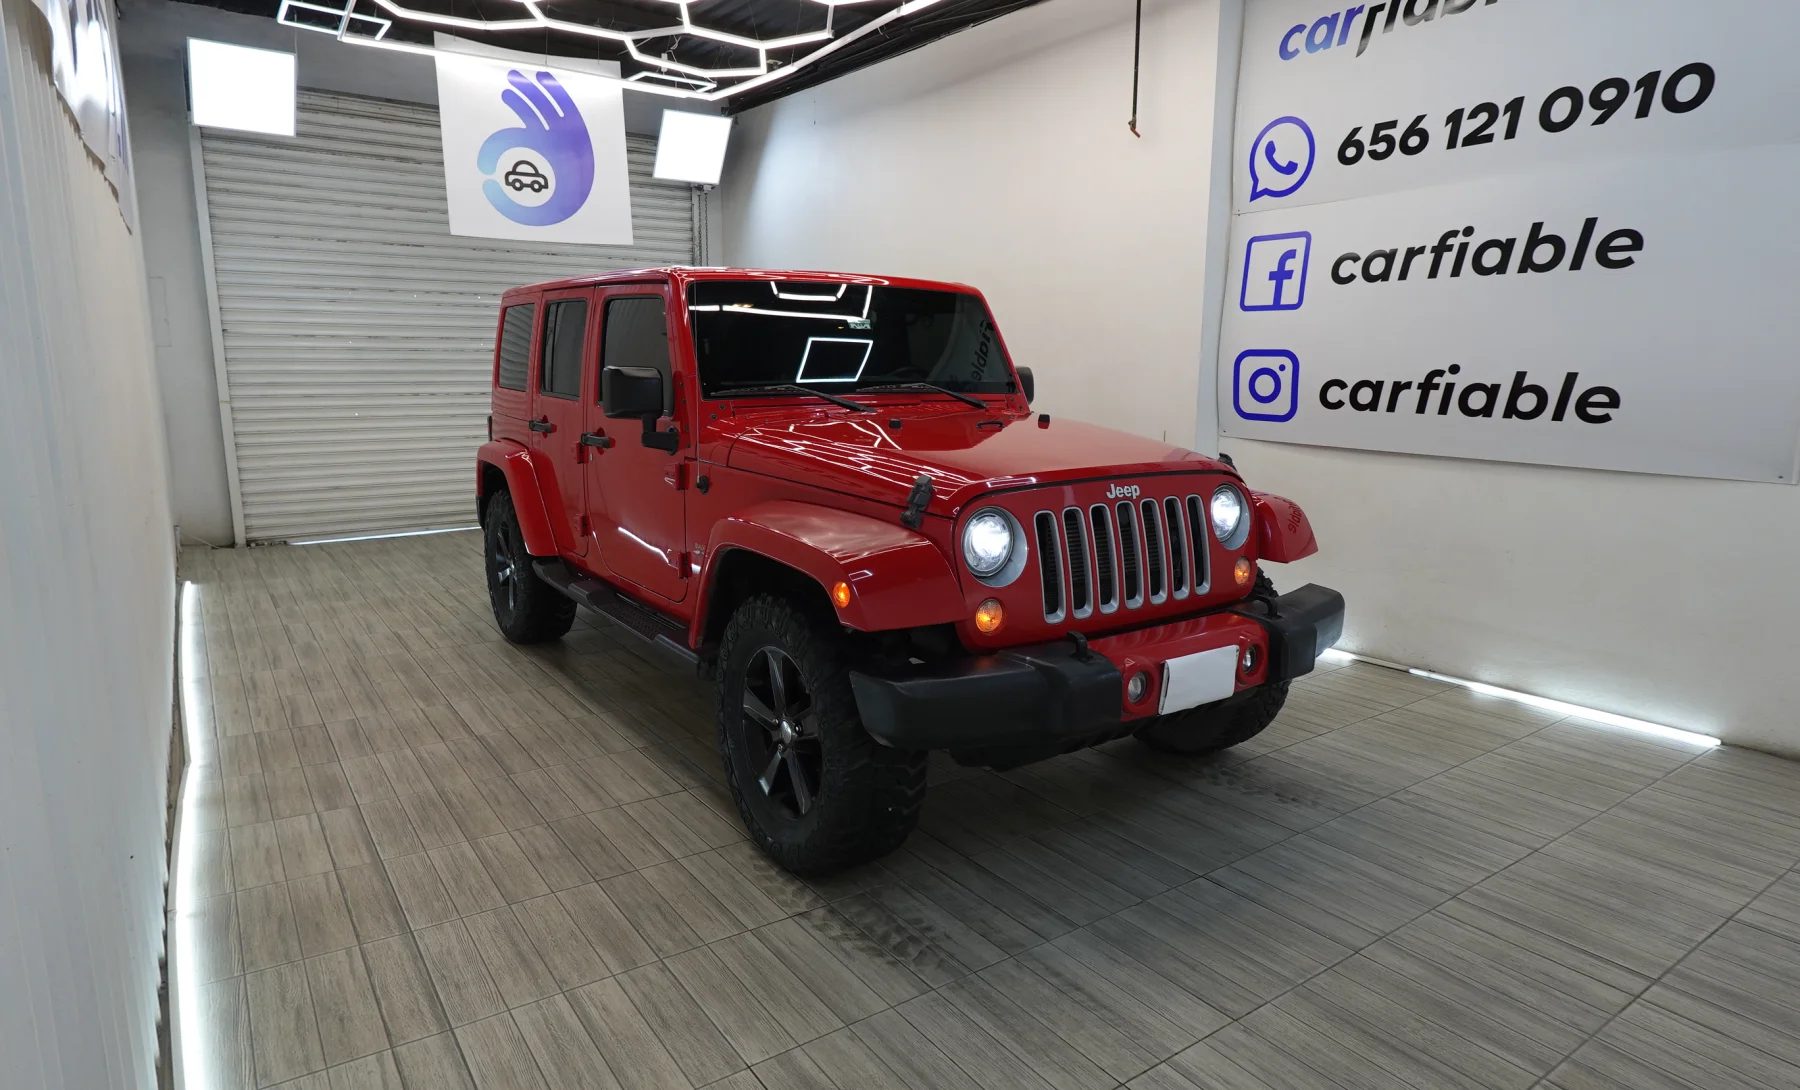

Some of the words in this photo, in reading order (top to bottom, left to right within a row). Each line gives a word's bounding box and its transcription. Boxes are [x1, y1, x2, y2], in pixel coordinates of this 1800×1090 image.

[1337, 113, 1430, 166] 656
[1444, 95, 1525, 150] 121
[1538, 62, 1716, 133] 0910
[1331, 217, 1644, 285] carfiable
[1319, 364, 1621, 425] carfiable
[1106, 483, 1141, 500] Jeep
